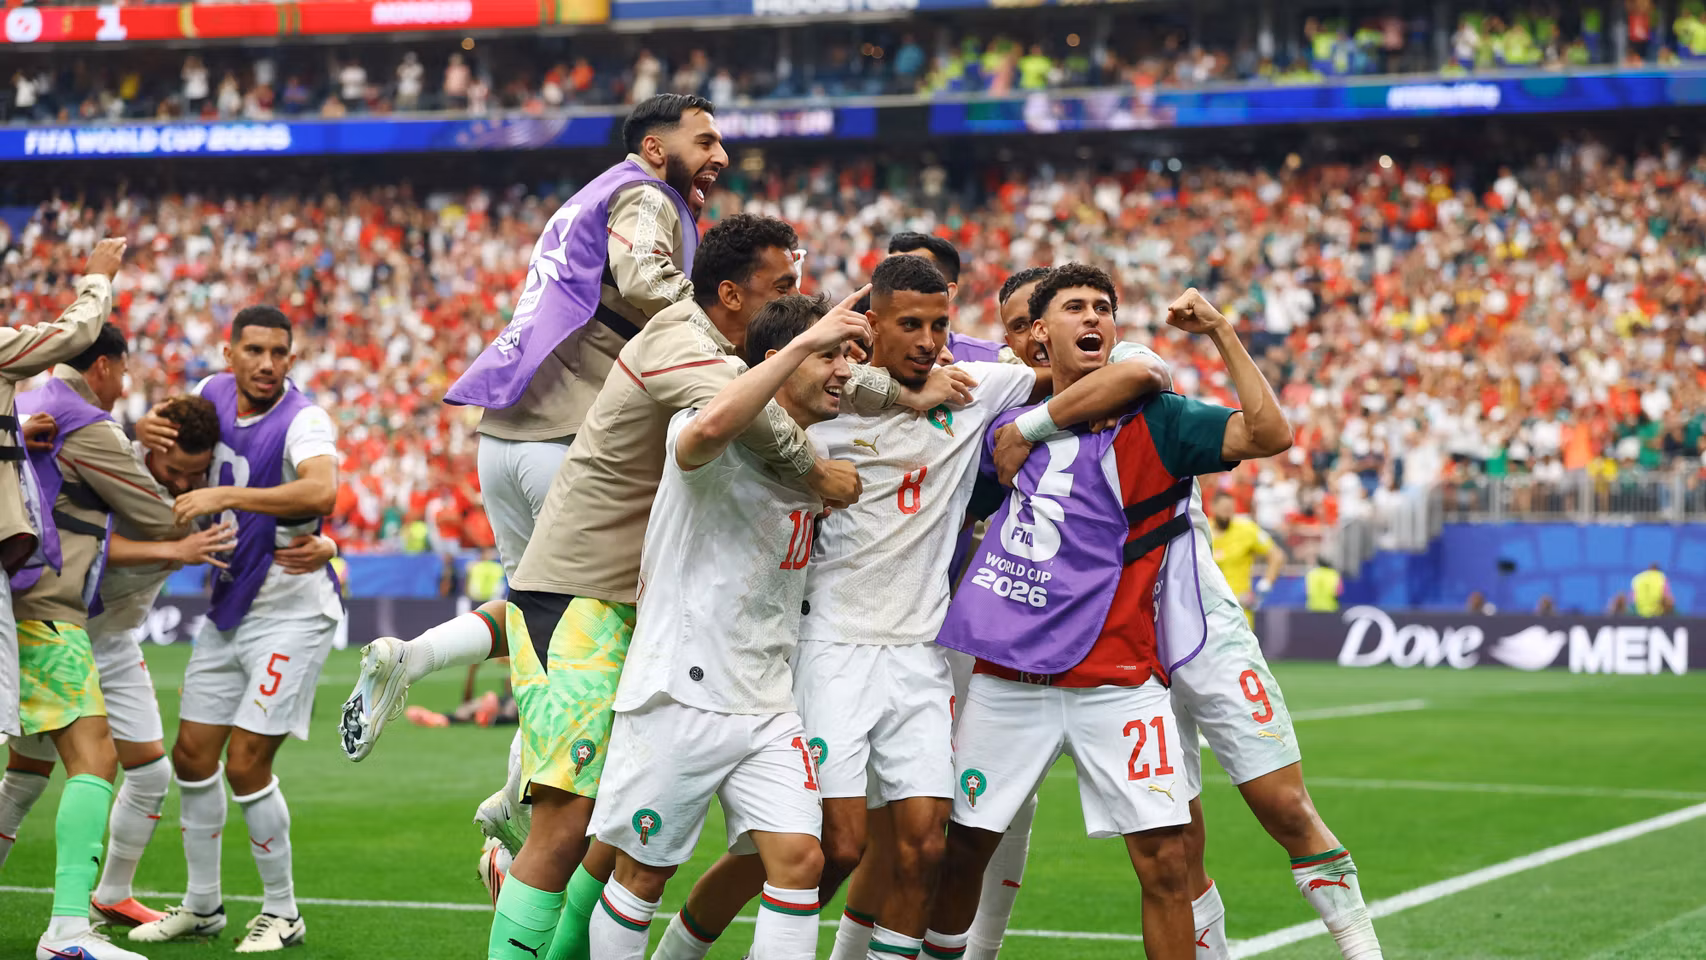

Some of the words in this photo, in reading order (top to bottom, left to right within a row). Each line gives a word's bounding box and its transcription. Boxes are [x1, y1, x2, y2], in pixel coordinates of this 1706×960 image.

[25, 129, 75, 155] FIFA
[76, 126, 159, 154] WORLD
[159, 125, 207, 153] CUP
[897, 465, 928, 515] 8
[779, 509, 815, 570] 10
[984, 551, 1026, 577] WORLD
[971, 567, 1048, 608] 2026
[1337, 604, 1486, 671] Dove
[1568, 625, 1690, 677] MEN
[259, 652, 291, 697] 5
[1238, 668, 1275, 725] 9
[791, 735, 822, 792] 1
[1122, 715, 1174, 781] 21
